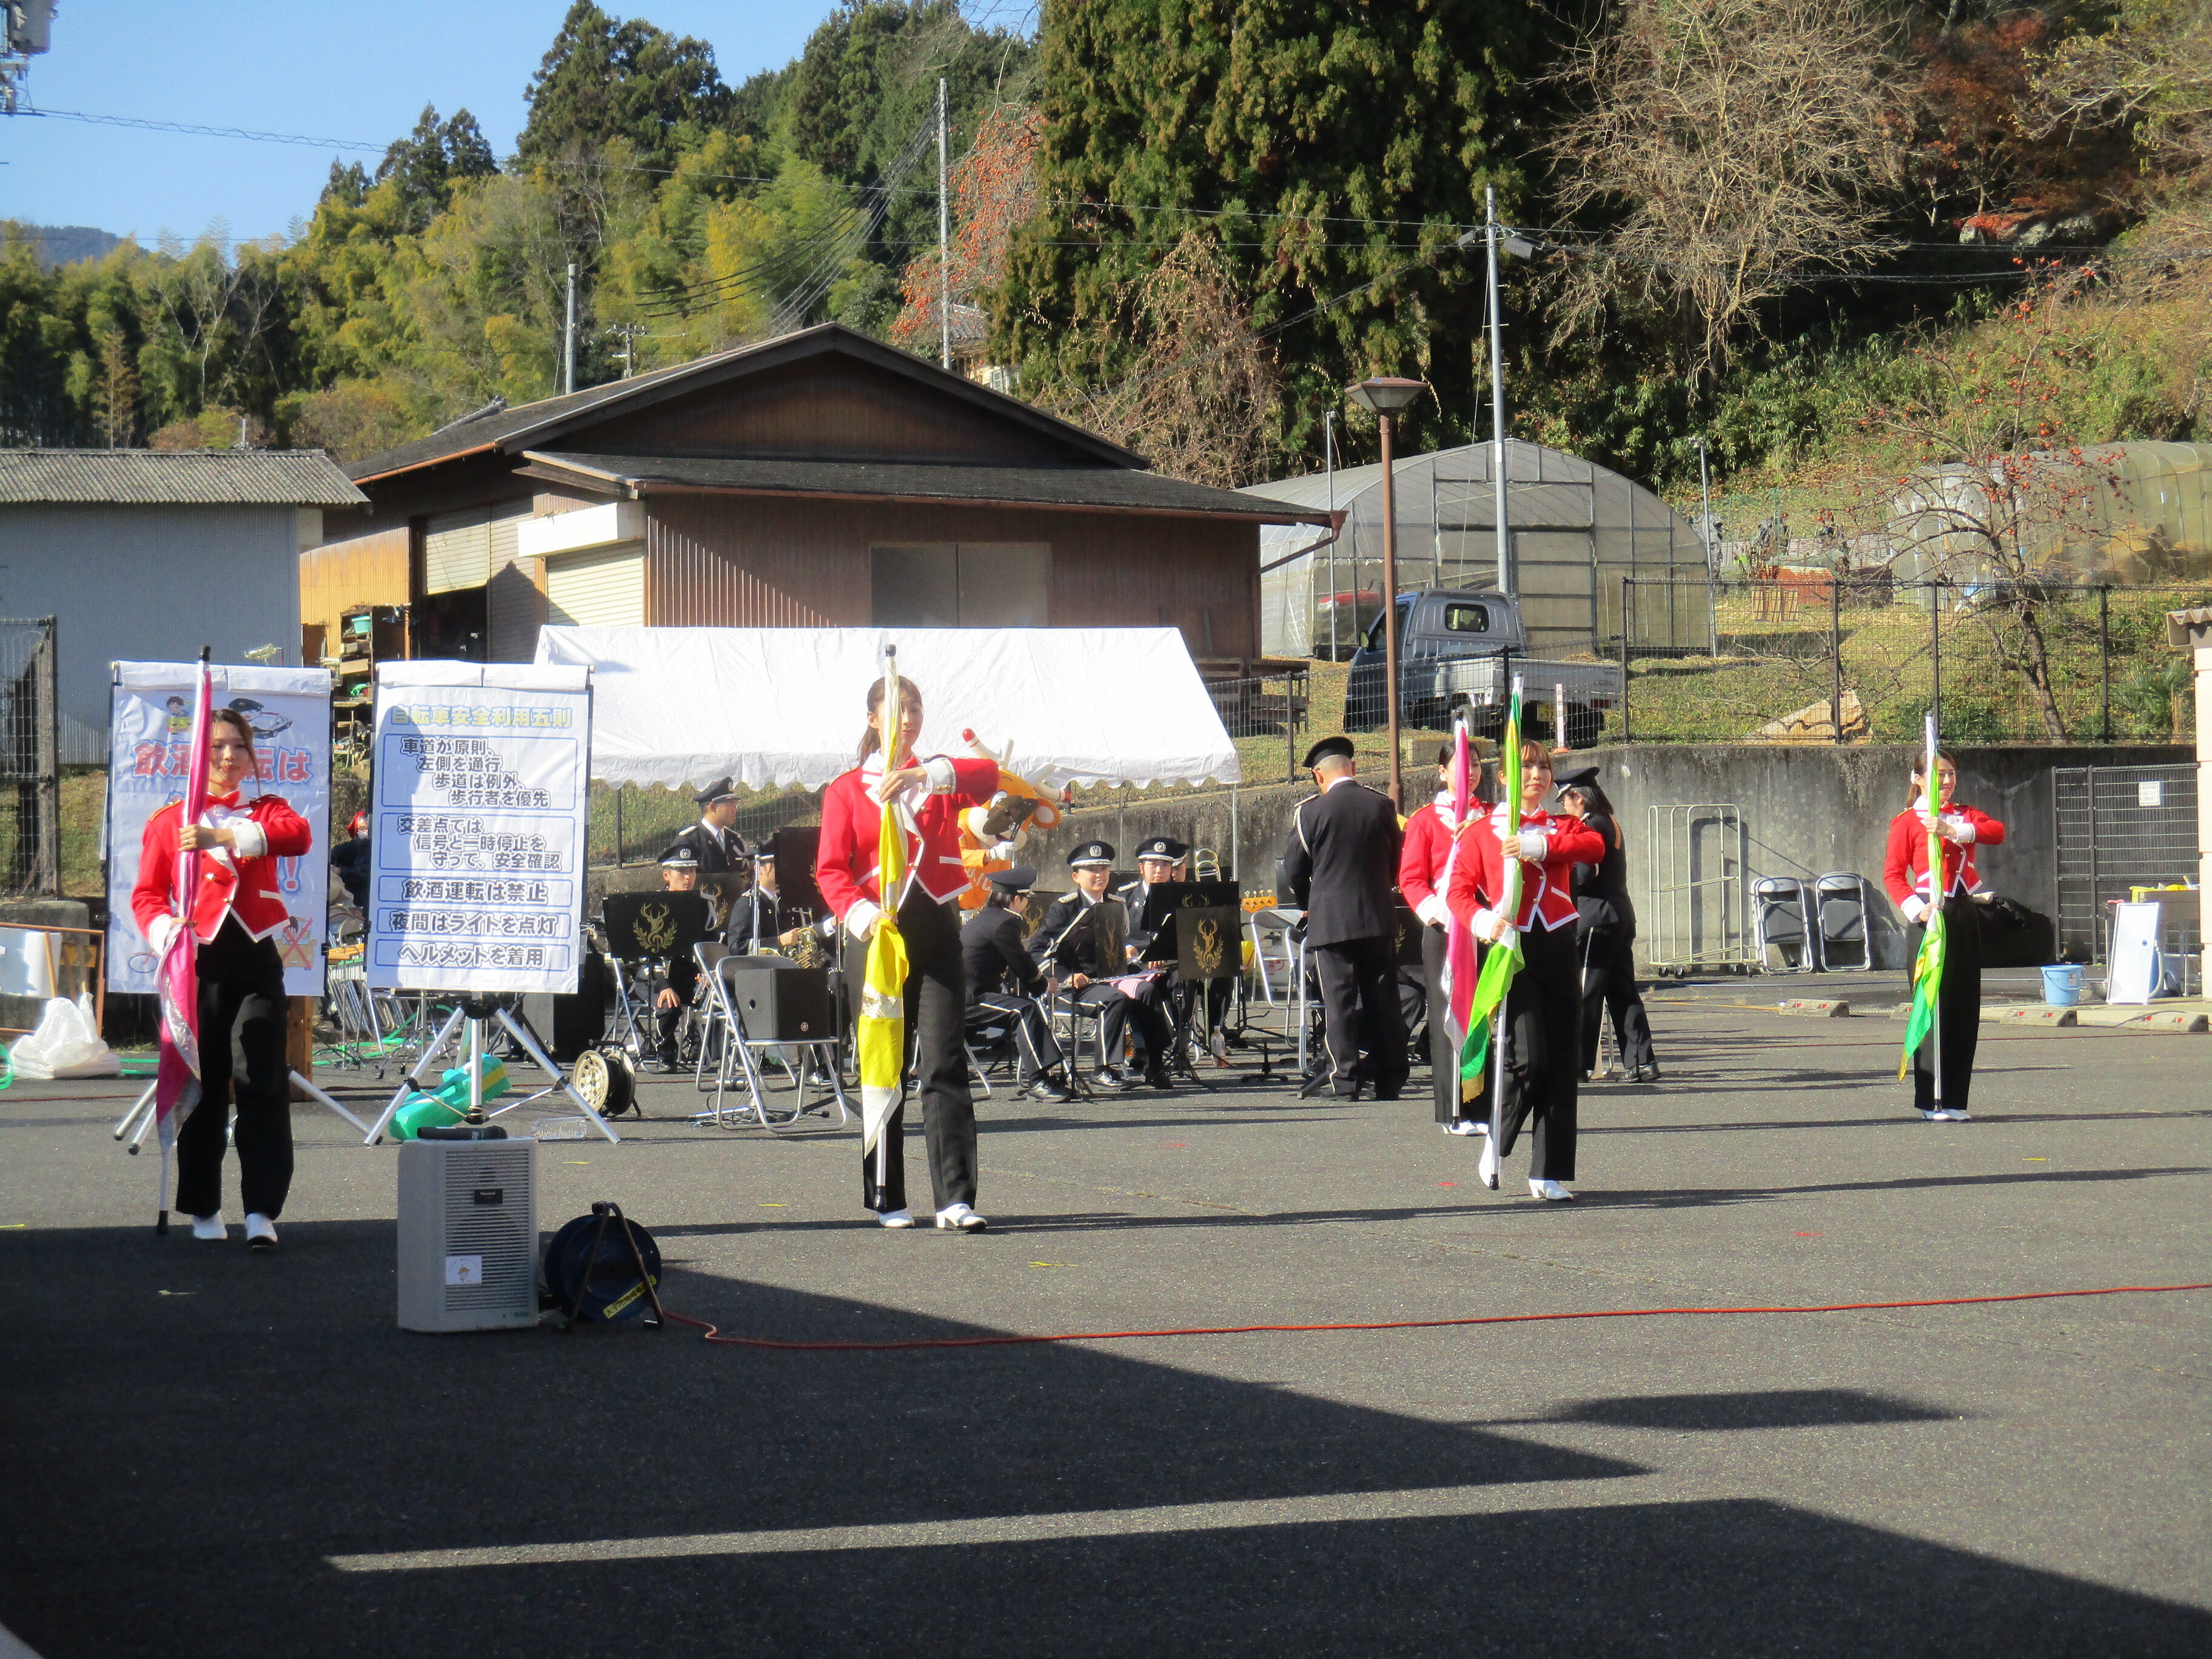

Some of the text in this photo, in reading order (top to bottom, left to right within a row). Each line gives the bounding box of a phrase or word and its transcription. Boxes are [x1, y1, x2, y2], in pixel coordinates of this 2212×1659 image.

[391, 705, 572, 728] 自転車安全利用五則
[401, 737, 494, 756] 車道が原則、
[418, 755, 502, 773] 左側を通行
[434, 772, 525, 790] 歩道は例外、
[451, 789, 550, 808] 歩行者を優先
[398, 816, 483, 834] 交差点では
[416, 833, 546, 853] 信号と一時停止を
[432, 851, 561, 870] 守って、安全確認
[403, 880, 548, 903] 飲酒運転は禁止
[391, 911, 557, 936] 夜間はライトを点灯
[400, 943, 546, 967] ヘルメットを着用
